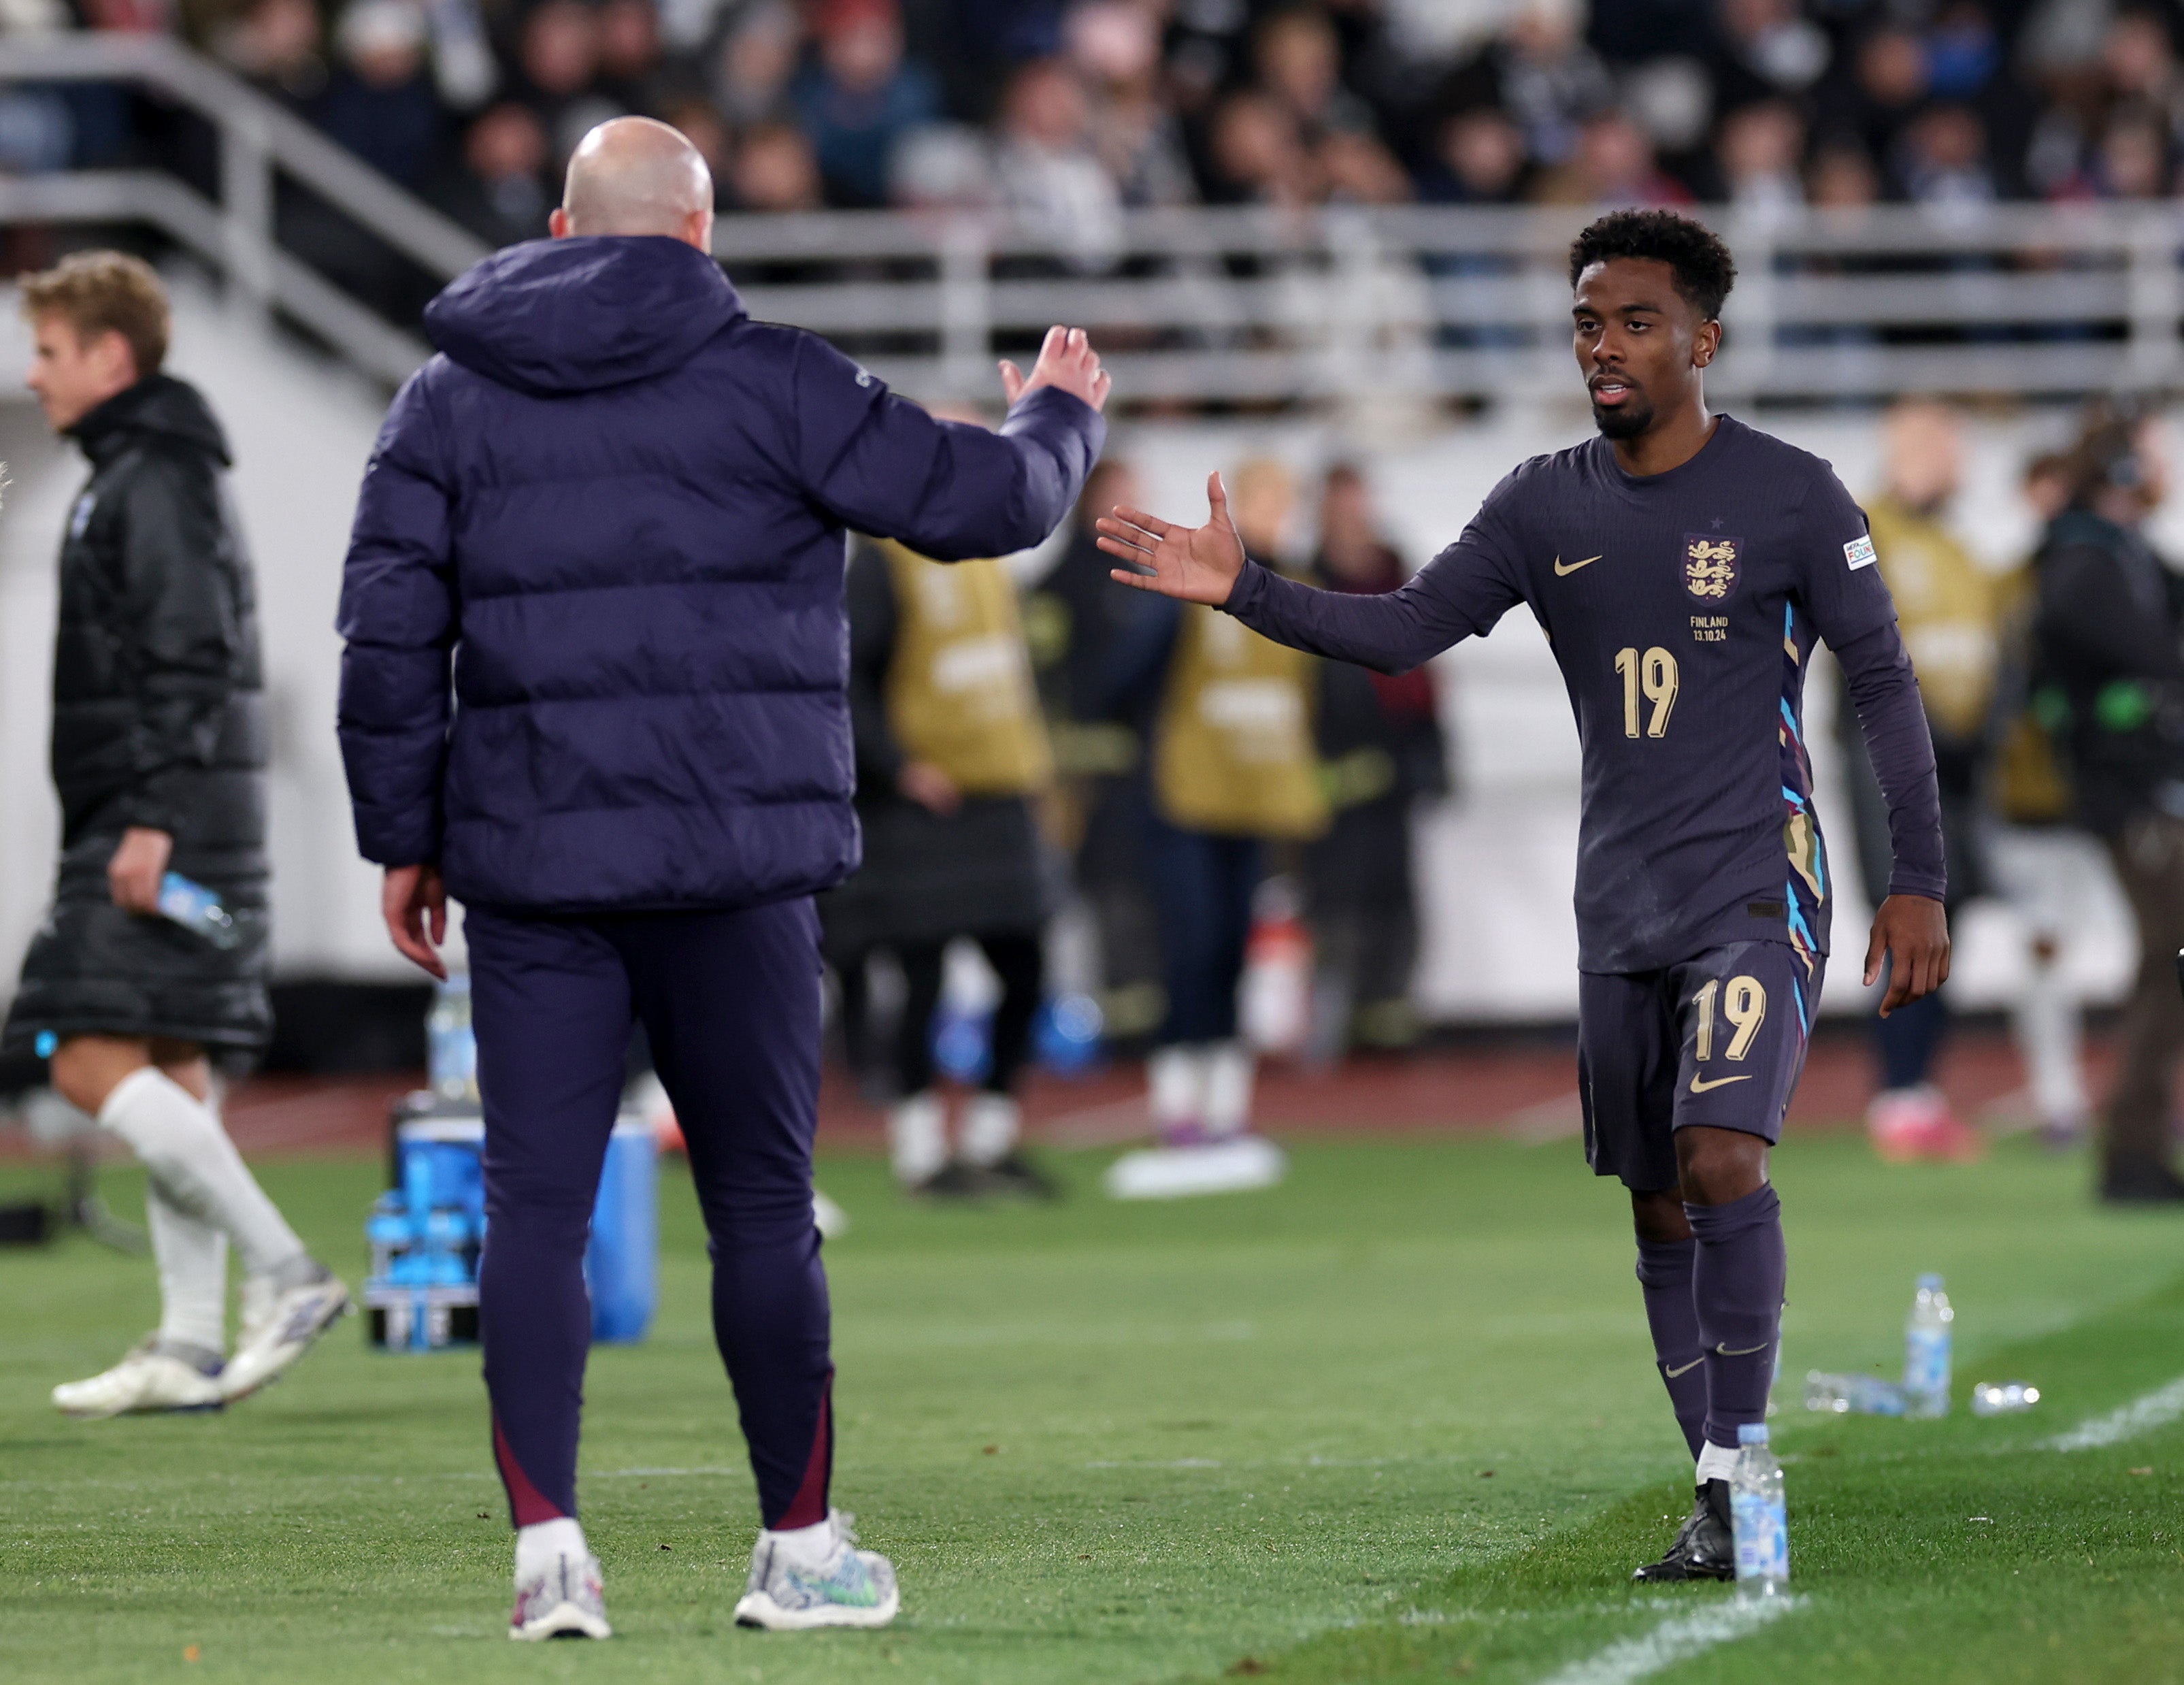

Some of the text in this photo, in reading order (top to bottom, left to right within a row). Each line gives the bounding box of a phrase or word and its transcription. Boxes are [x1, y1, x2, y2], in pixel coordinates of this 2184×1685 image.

[1690, 616, 1728, 627] FINLAND
[1693, 629, 1726, 641] 13.10.24
[1615, 647, 1678, 738] 19
[1692, 976, 1766, 1061] 19
